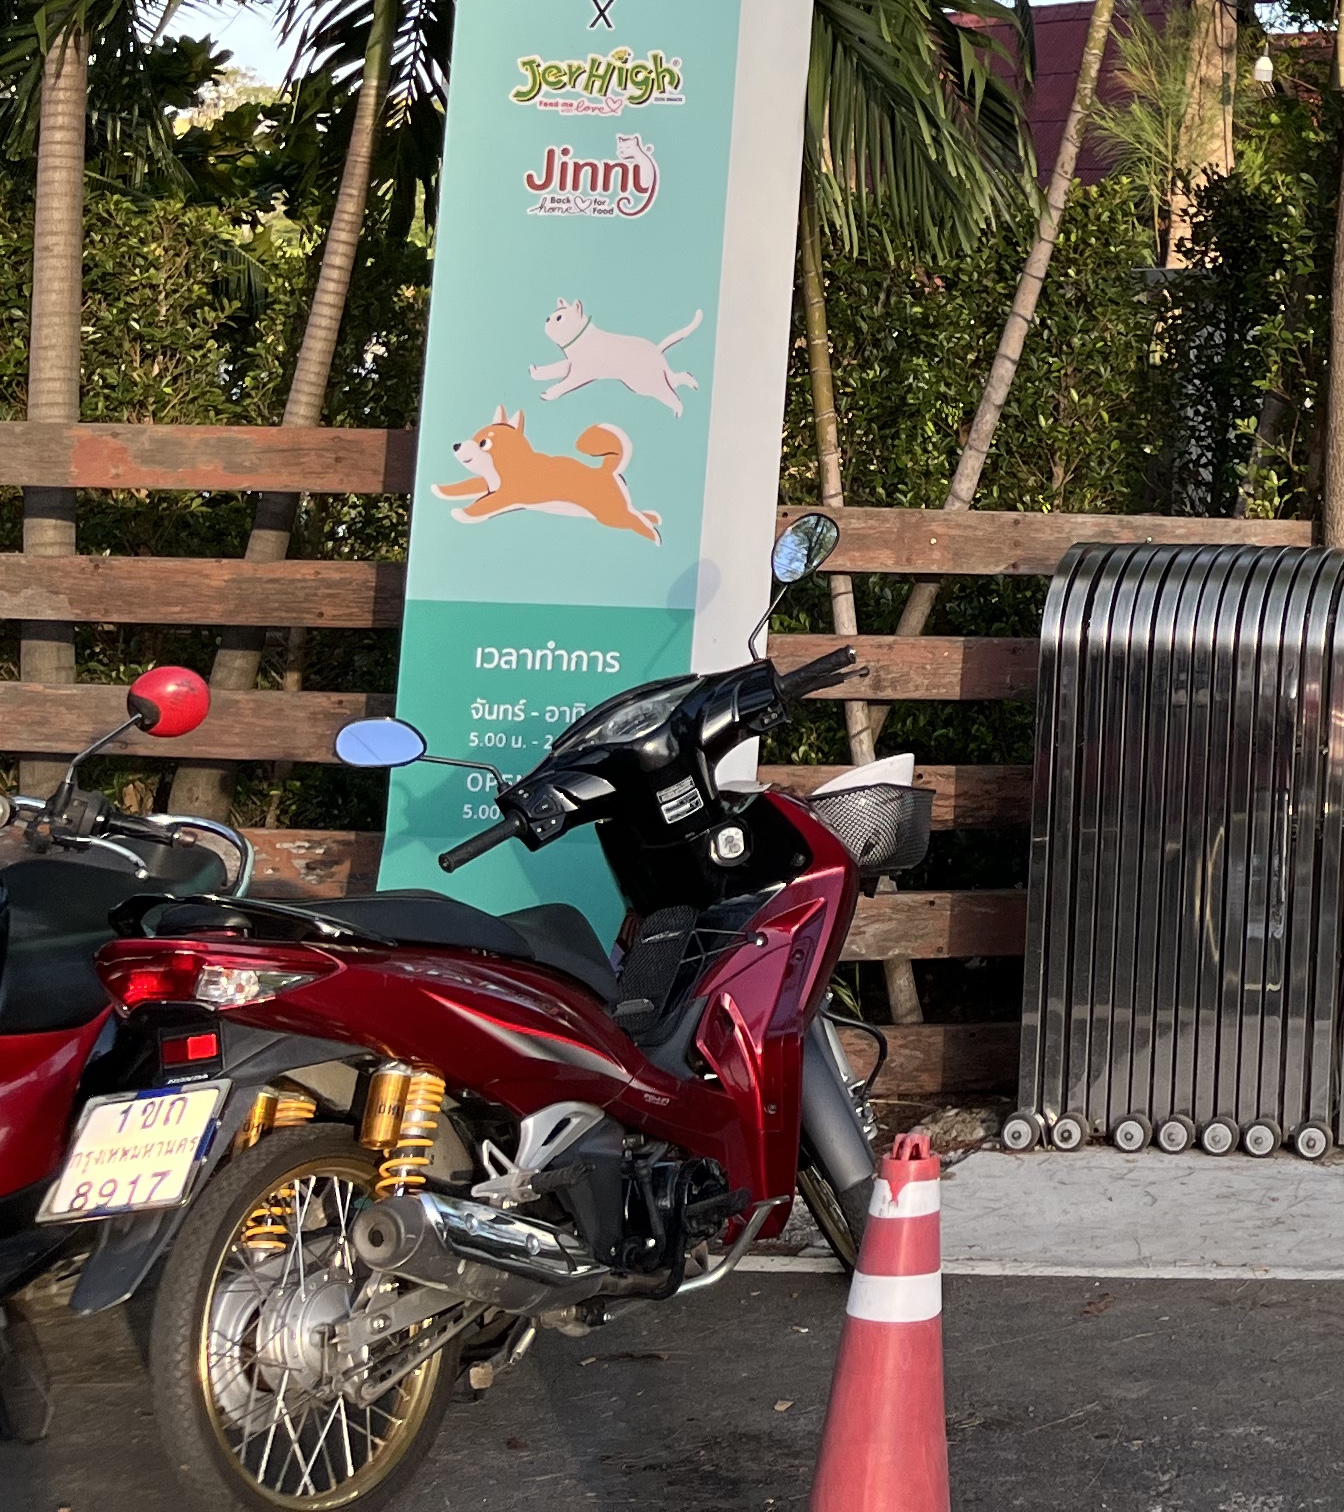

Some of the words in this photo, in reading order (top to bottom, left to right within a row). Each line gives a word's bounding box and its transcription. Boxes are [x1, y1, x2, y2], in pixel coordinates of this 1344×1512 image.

[512, 50, 681, 105] JerHigh
[525, 147, 657, 217] Jinny
[550, 196, 571, 205] Back
[594, 199, 606, 207] for
[592, 206, 614, 216] Food
[475, 640, 621, 674] เวลาทำการ
[470, 696, 527, 722] จันทร์
[544, 702, 587, 724] อาทิ
[468, 731, 507, 748] 5.00
[69, 1169, 173, 1212] 8917
